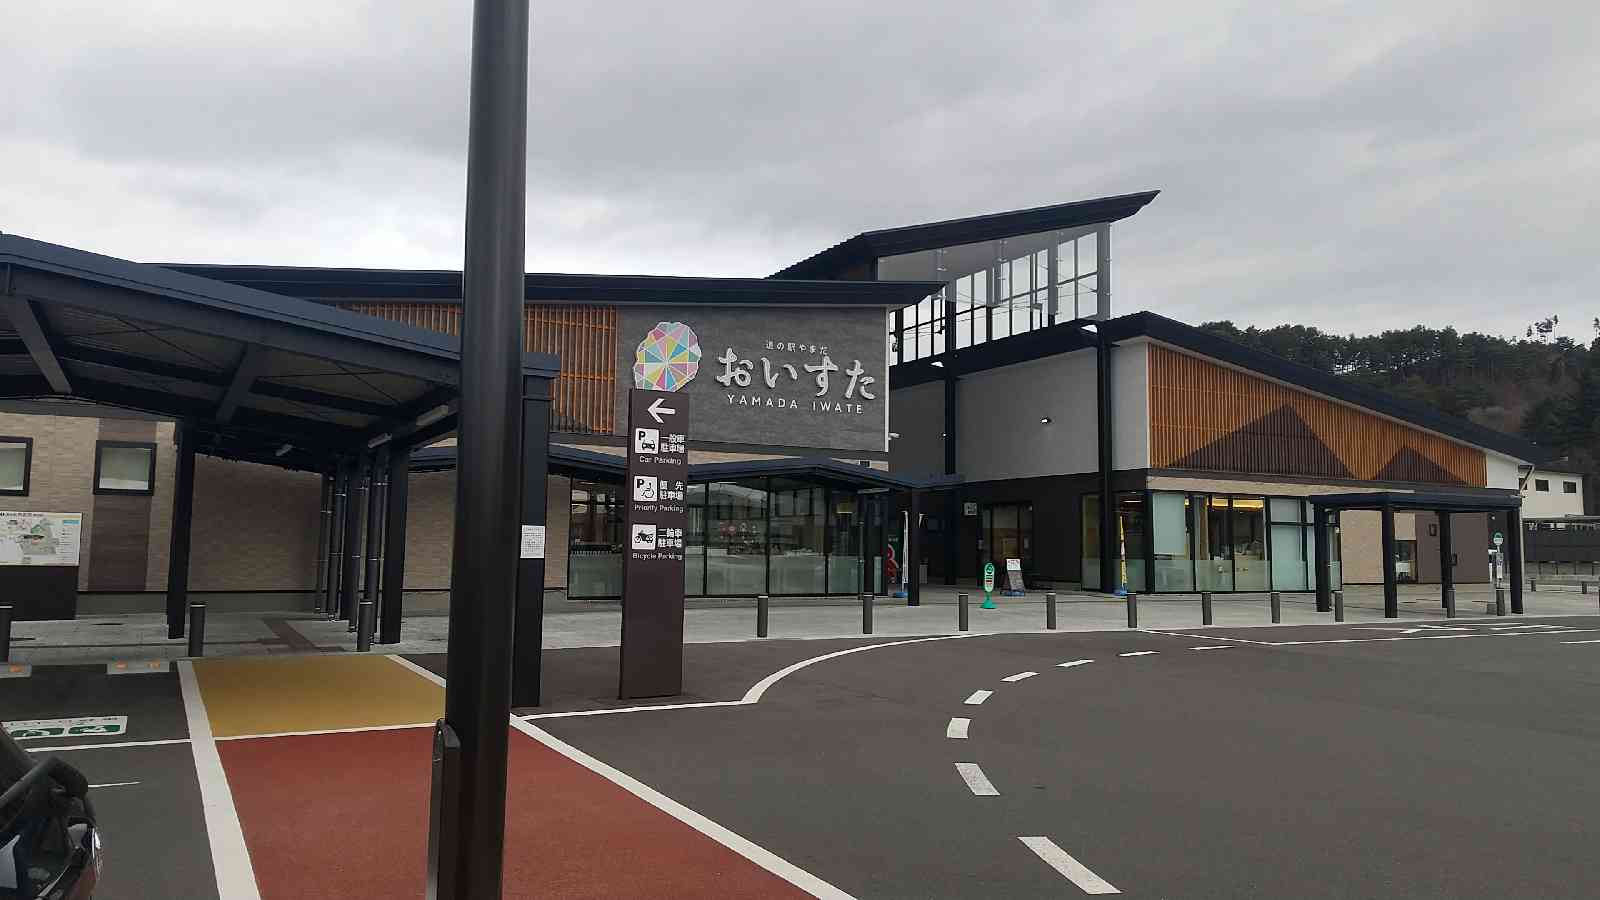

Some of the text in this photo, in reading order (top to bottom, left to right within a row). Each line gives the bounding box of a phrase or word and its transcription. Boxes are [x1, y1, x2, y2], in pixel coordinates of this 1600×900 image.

[766, 341, 828, 356] 道の駅やまだ
[716, 348, 876, 400] おいすた
[727, 394, 864, 414] YAMADA IWATE
[638, 431, 646, 440] P
[660, 434, 685, 443] 一般車
[660, 443, 685, 453] 駐車場
[654, 457, 682, 465] Parking
[636, 478, 645, 488] P
[660, 490, 684, 501] 駐車場
[634, 504, 684, 513] Priority Parking
[658, 527, 683, 538] 二輪車
[658, 537, 683, 548] 駐車場
[632, 552, 657, 560] Bicycle
